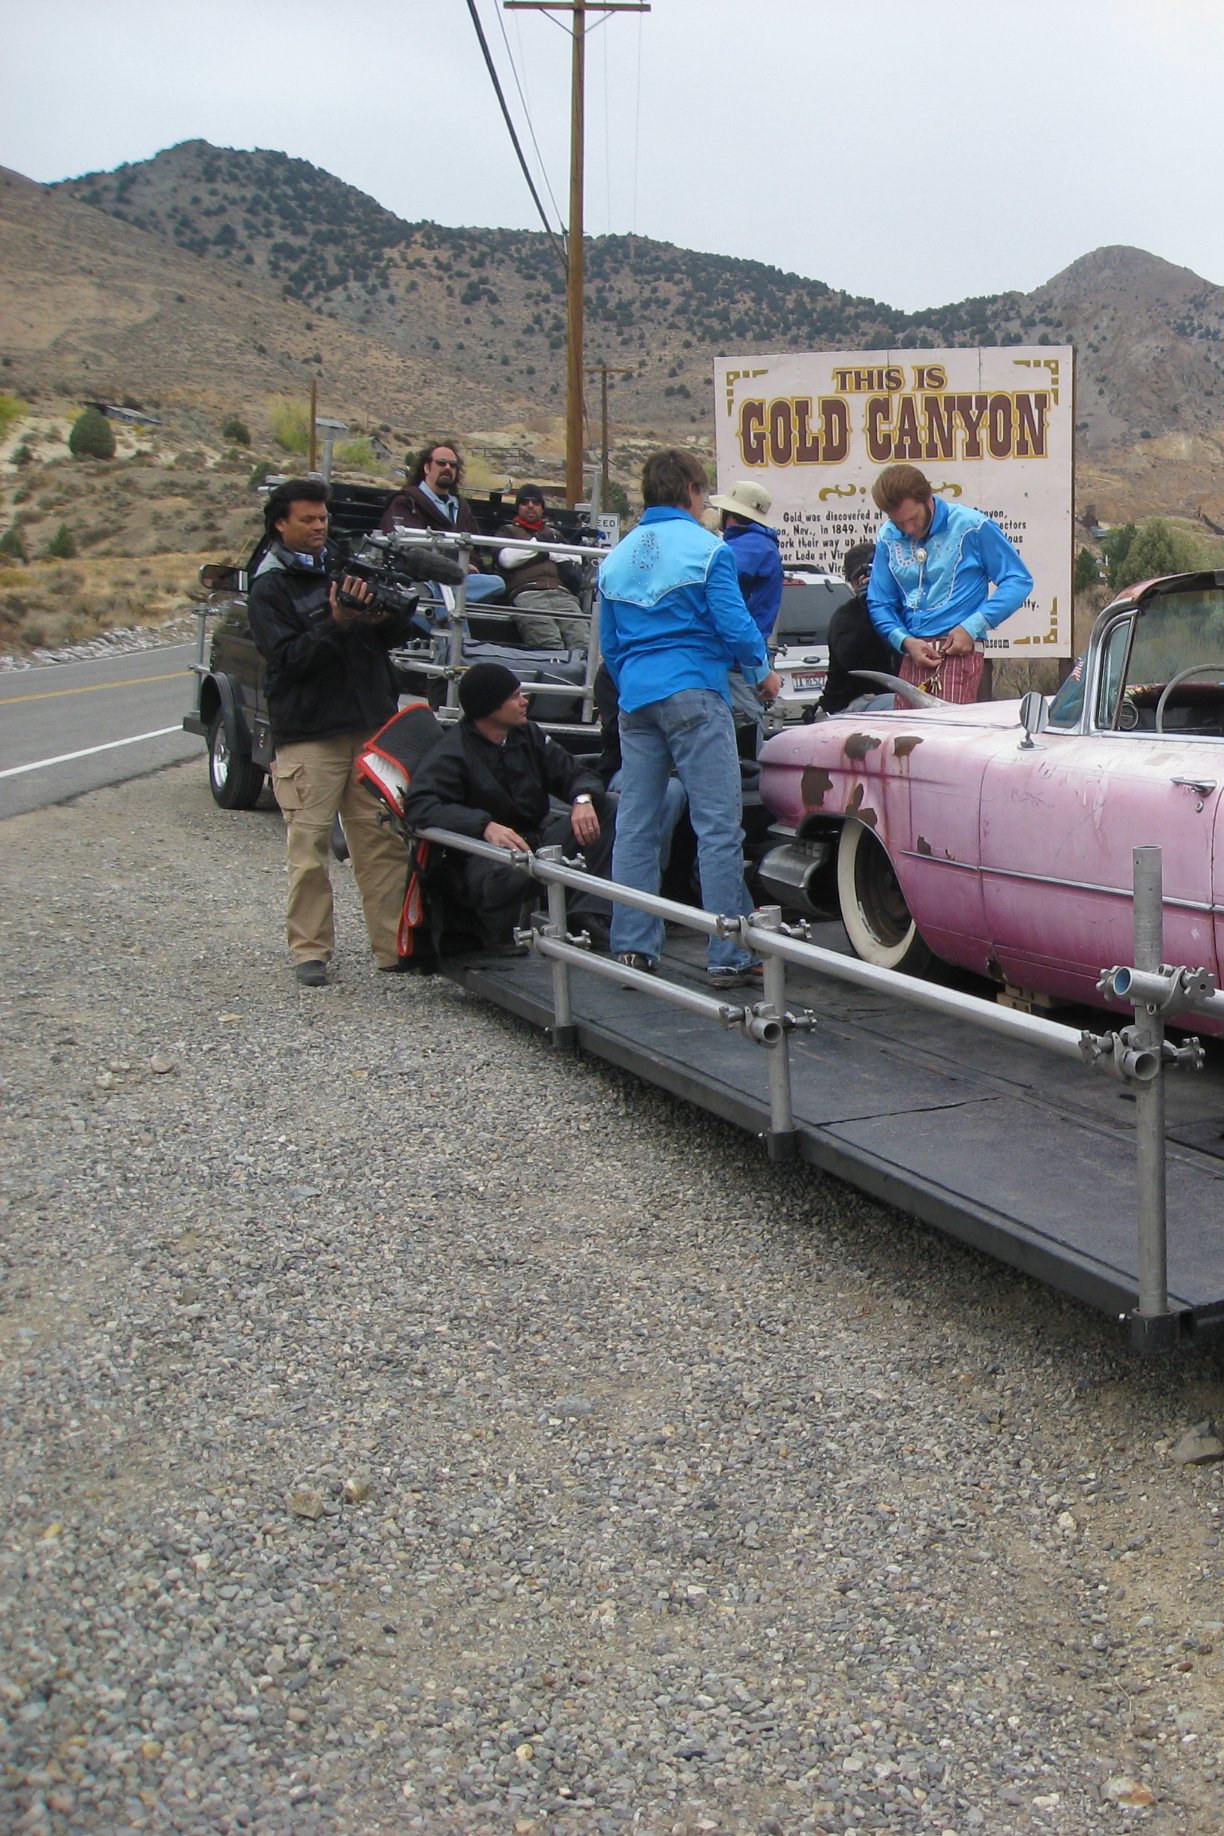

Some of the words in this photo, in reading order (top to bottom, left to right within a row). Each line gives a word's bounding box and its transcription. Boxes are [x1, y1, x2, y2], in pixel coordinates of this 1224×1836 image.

[834, 366, 904, 393] THIS
[914, 366, 946, 391] IS
[738, 397, 851, 466] GOLD
[864, 391, 1050, 463] CANYON
[783, 511, 802, 522] Gold
[826, 510, 870, 521] discovered
[874, 511, 883, 520] at
[821, 525, 829, 534] in
[832, 524, 858, 534] 1849.
[863, 523, 877, 534] Yet
[996, 521, 1027, 530] ectors
[798, 538, 819, 548] their
[823, 540, 839, 550] way
[845, 539, 856, 547] up
[796, 551, 815, 560] Lode
[819, 552, 827, 560] at
